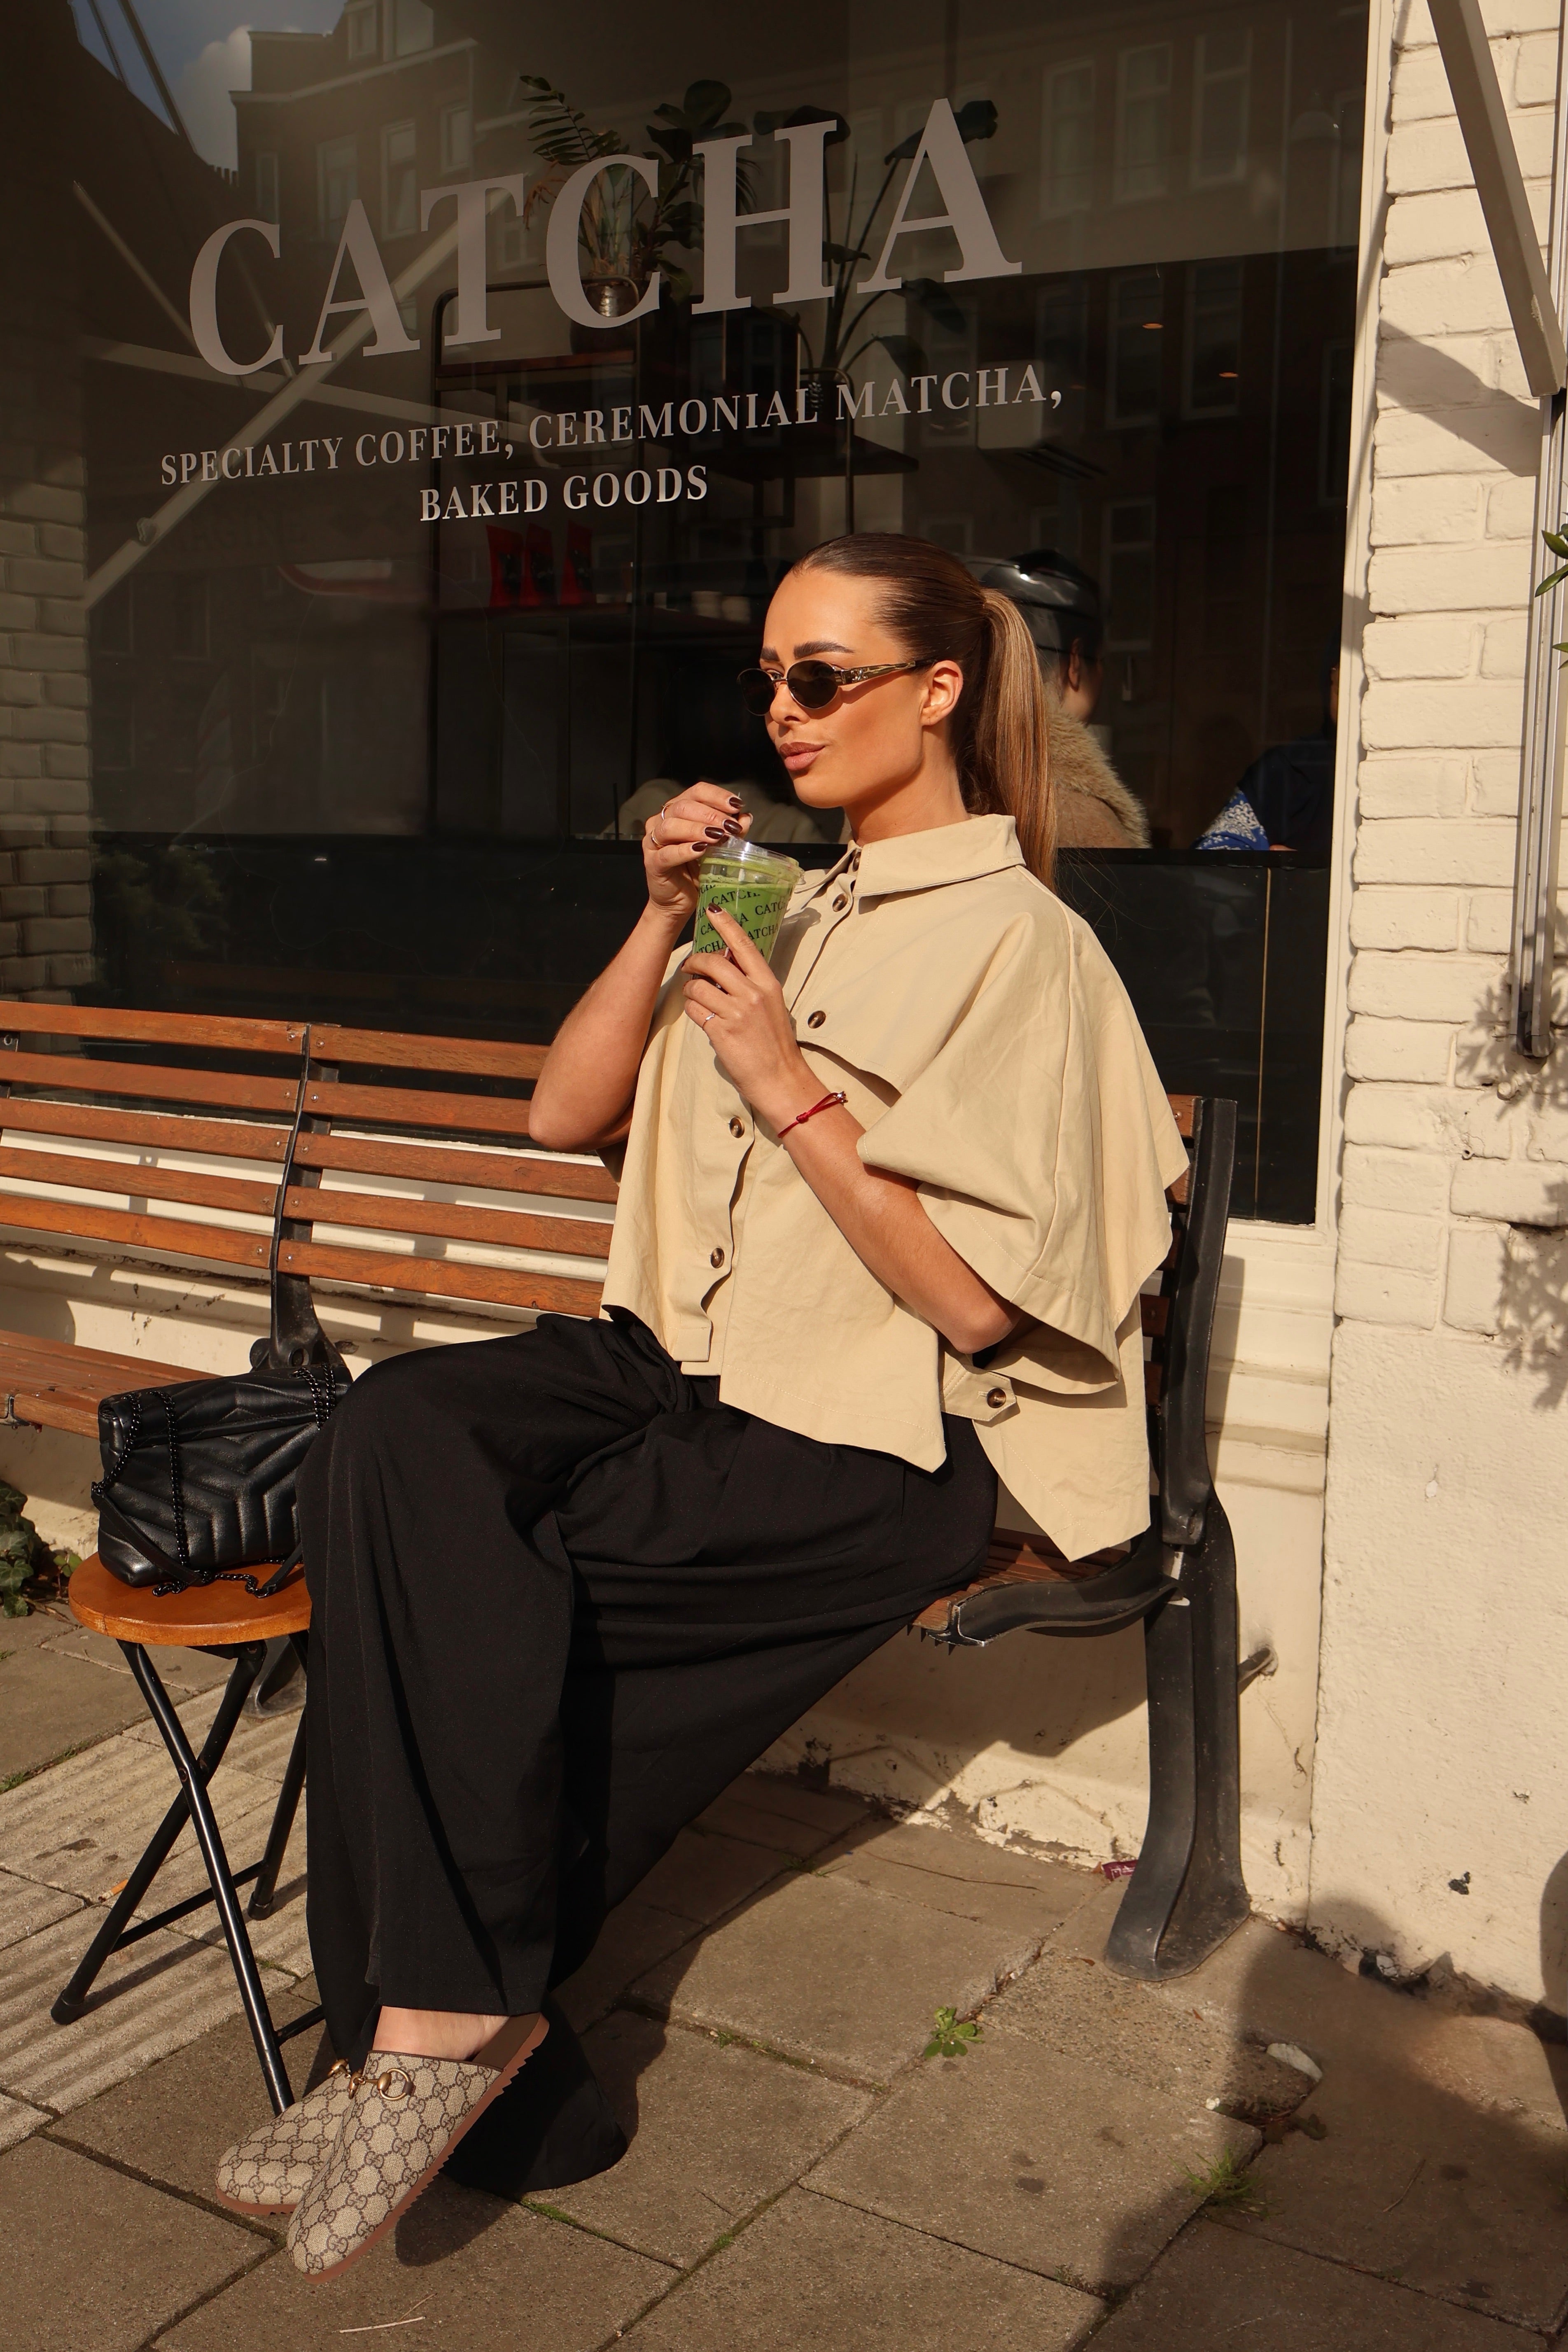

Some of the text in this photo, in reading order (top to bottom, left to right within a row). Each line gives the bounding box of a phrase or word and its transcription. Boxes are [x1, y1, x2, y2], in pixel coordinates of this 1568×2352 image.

[189, 98, 1022, 376] CATCHA
[161, 364, 1062, 485] SPECIALTY COFFEE, CEREMONIAL MATCHA,
[420, 465, 707, 522] BAKED GOODS
[712, 889, 761, 905] CATC
[755, 901, 785, 915] CATC
